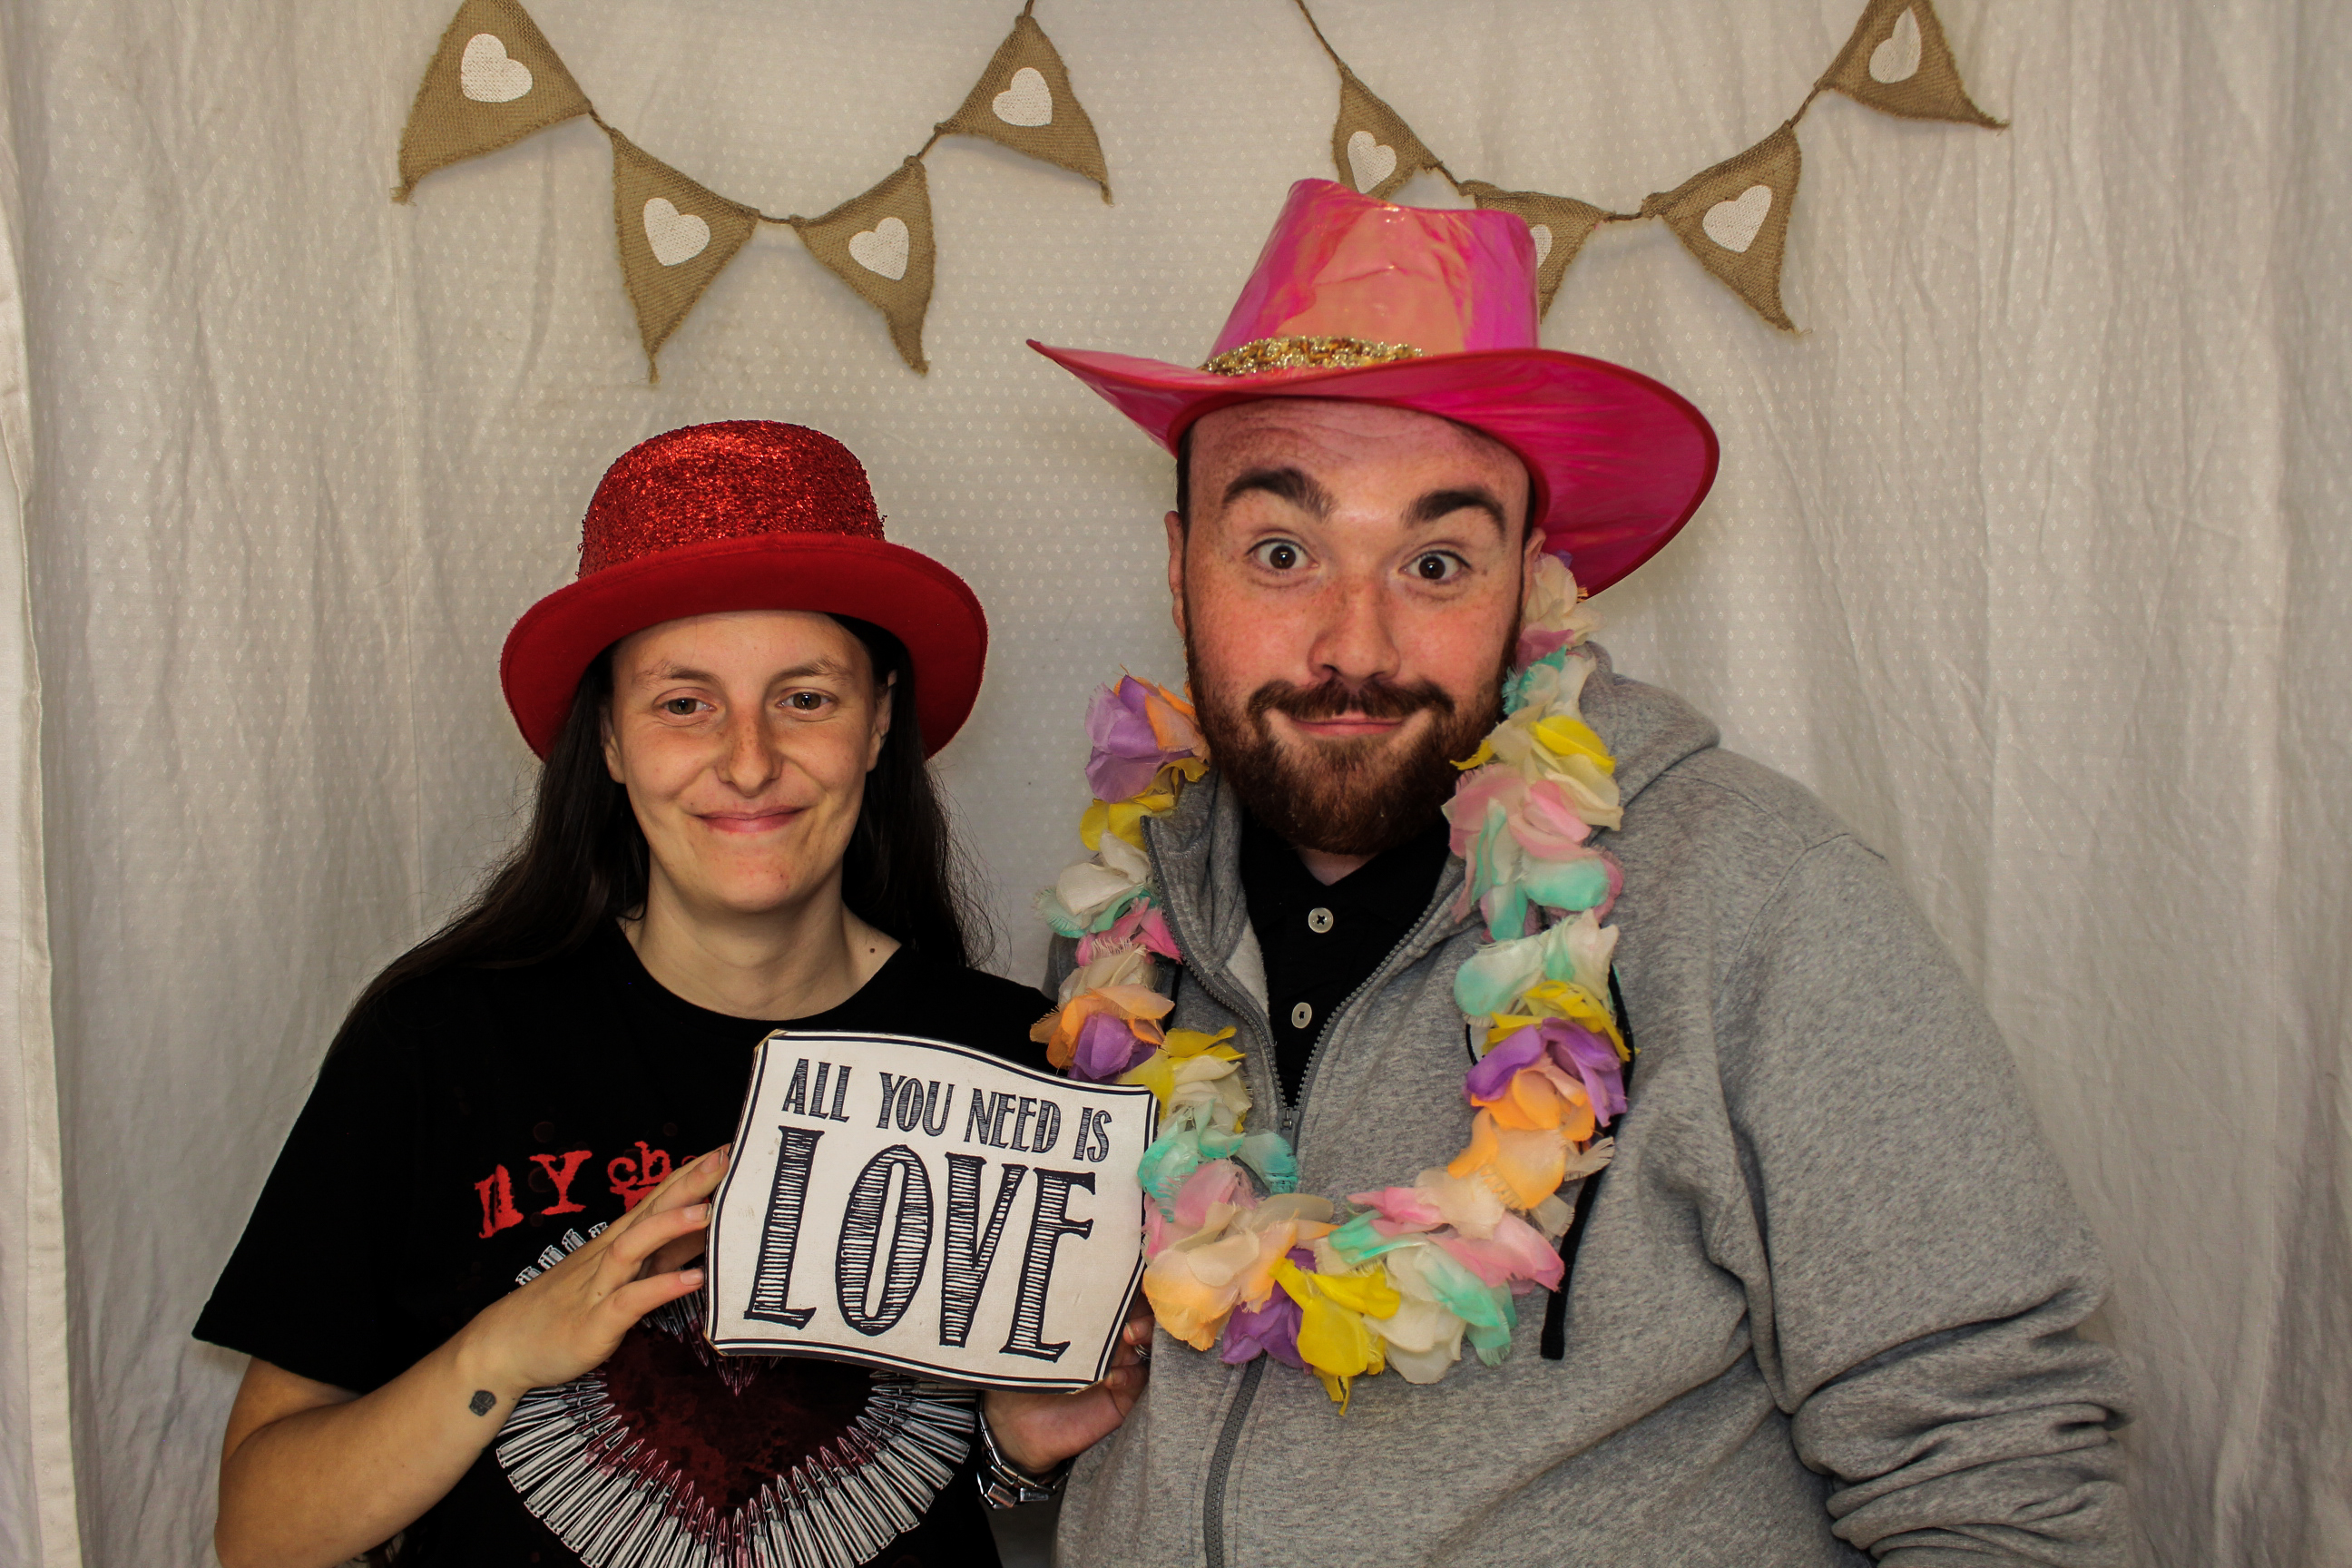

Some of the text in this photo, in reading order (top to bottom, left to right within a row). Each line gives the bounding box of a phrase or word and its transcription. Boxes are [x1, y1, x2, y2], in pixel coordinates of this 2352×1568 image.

[781, 1058, 1112, 1162] ALL YOU NEED IS
[743, 1125, 1096, 1363] LOVE
